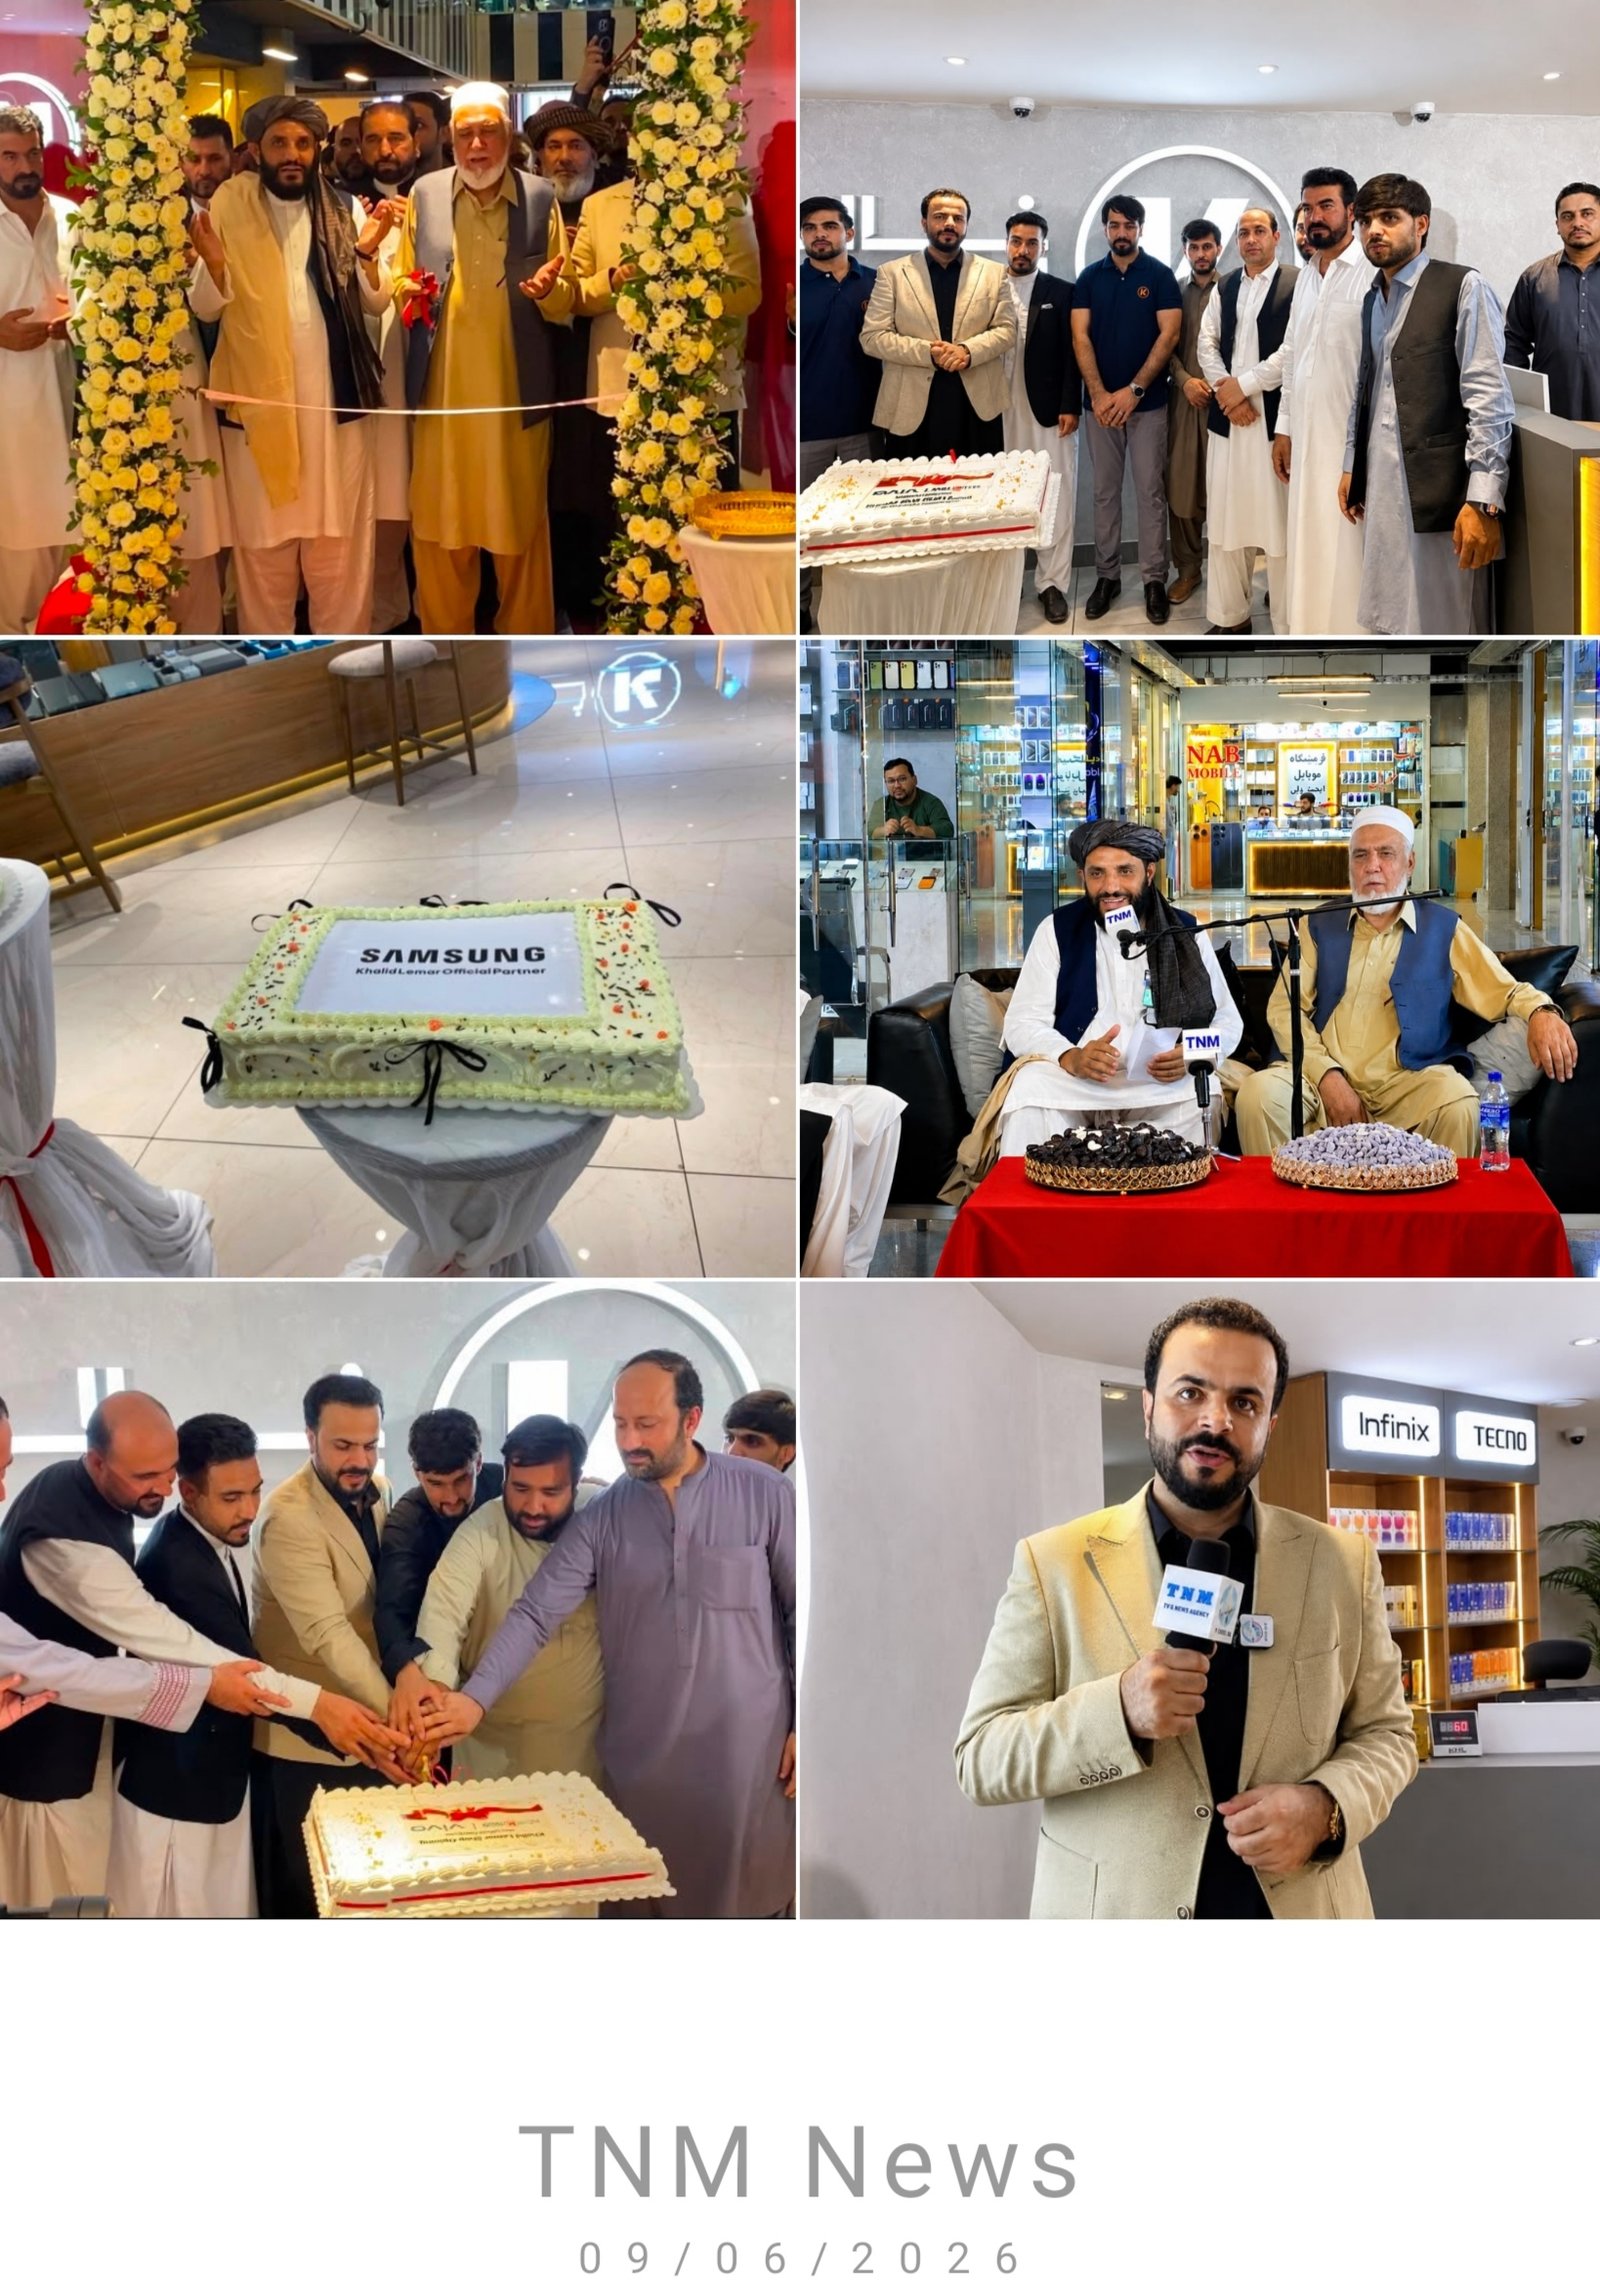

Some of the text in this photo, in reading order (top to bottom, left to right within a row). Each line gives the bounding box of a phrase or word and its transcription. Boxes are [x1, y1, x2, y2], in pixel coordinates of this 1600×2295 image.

[1187, 745, 1240, 765] NAB
[1187, 768, 1241, 779] MOBILE
[1293, 769, 1322, 782] موبایل
[1106, 910, 1132, 924] TNM
[360, 946, 546, 964] SAMSUNG
[355, 967, 547, 975] Khalid Lemar Official Partner
[1185, 1035, 1220, 1049] TNM
[1359, 1411, 1430, 1442] Infinix
[1473, 1425, 1527, 1451] TECNO
[1167, 1583, 1214, 1606] TNM
[1174, 1605, 1189, 1614] NEWS
[1189, 1609, 1209, 1618] AGENCY
